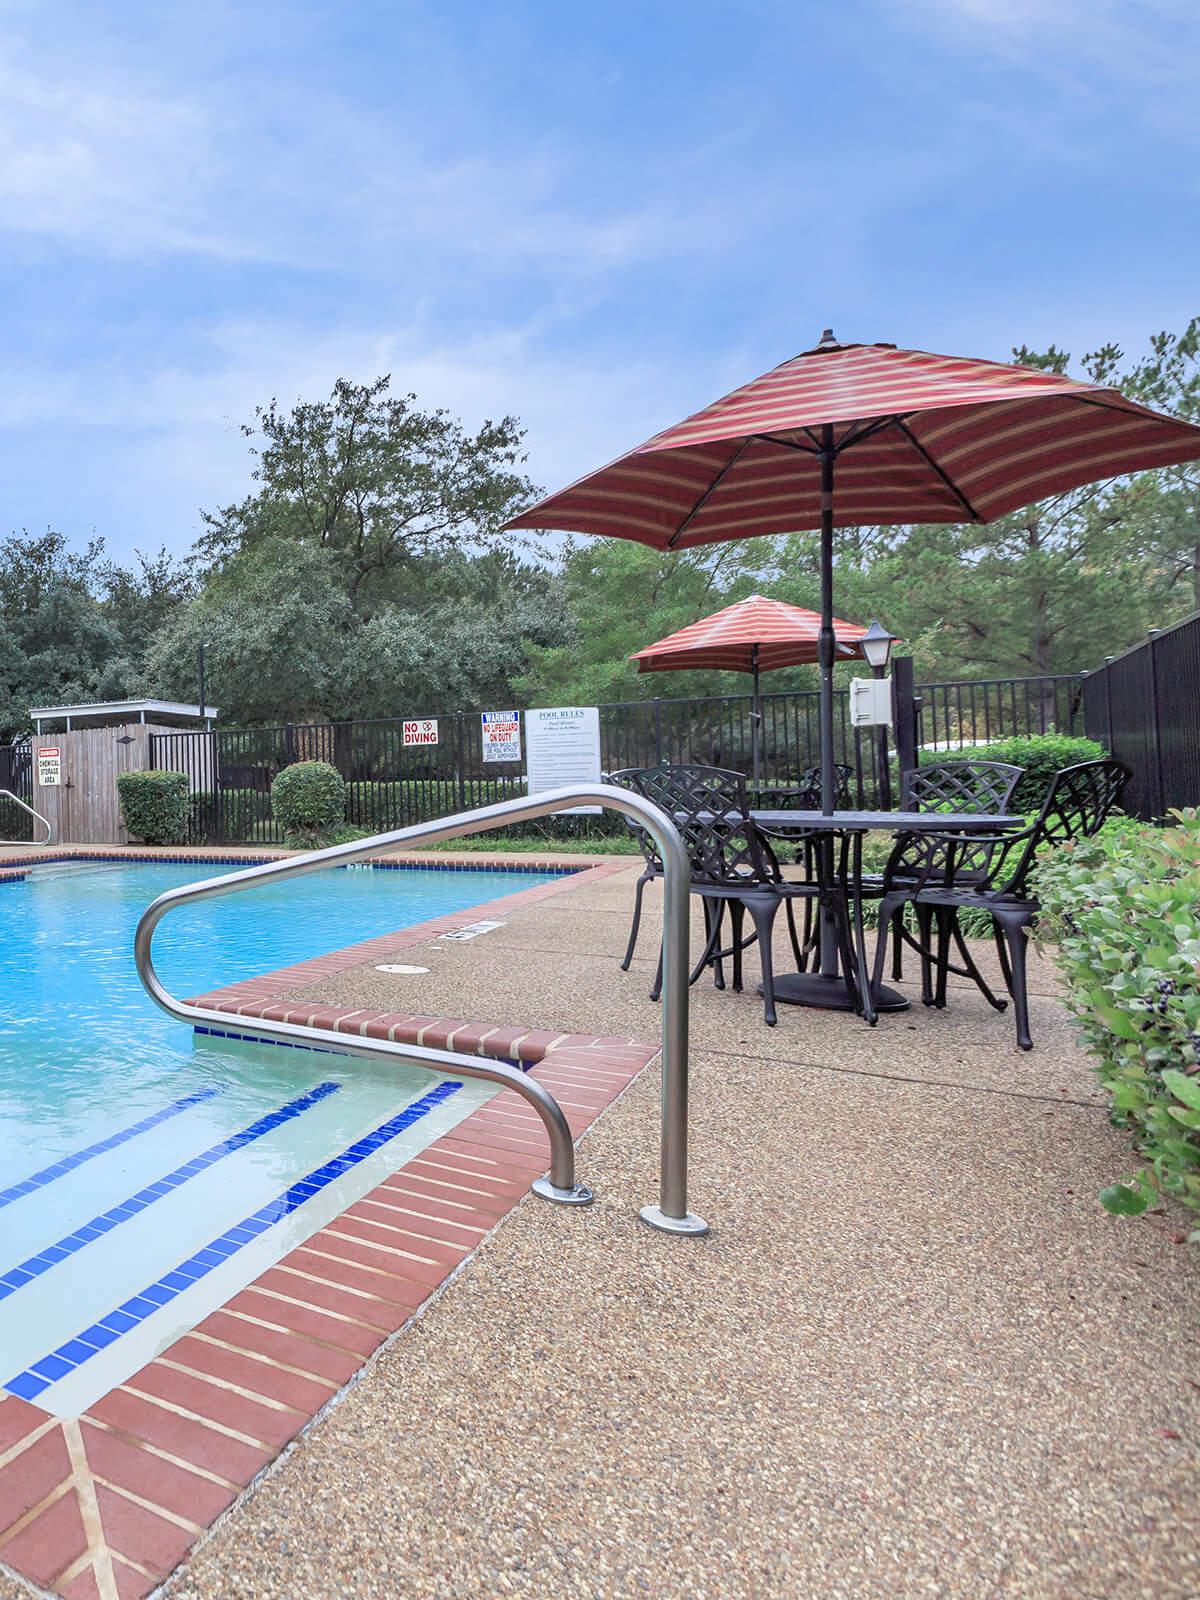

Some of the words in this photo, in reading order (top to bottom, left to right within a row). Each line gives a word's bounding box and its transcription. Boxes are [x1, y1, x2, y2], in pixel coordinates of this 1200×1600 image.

[487, 712, 514, 722] WARNING
[540, 711, 557, 719] POOL
[560, 710, 584, 718] RULES
[404, 723, 417, 732] NO
[484, 724, 490, 732] NO
[492, 723, 518, 732] LIFEGUARD
[404, 733, 436, 743] DIVING
[490, 734, 497, 742] ON
[498, 733, 512, 742] DUTY
